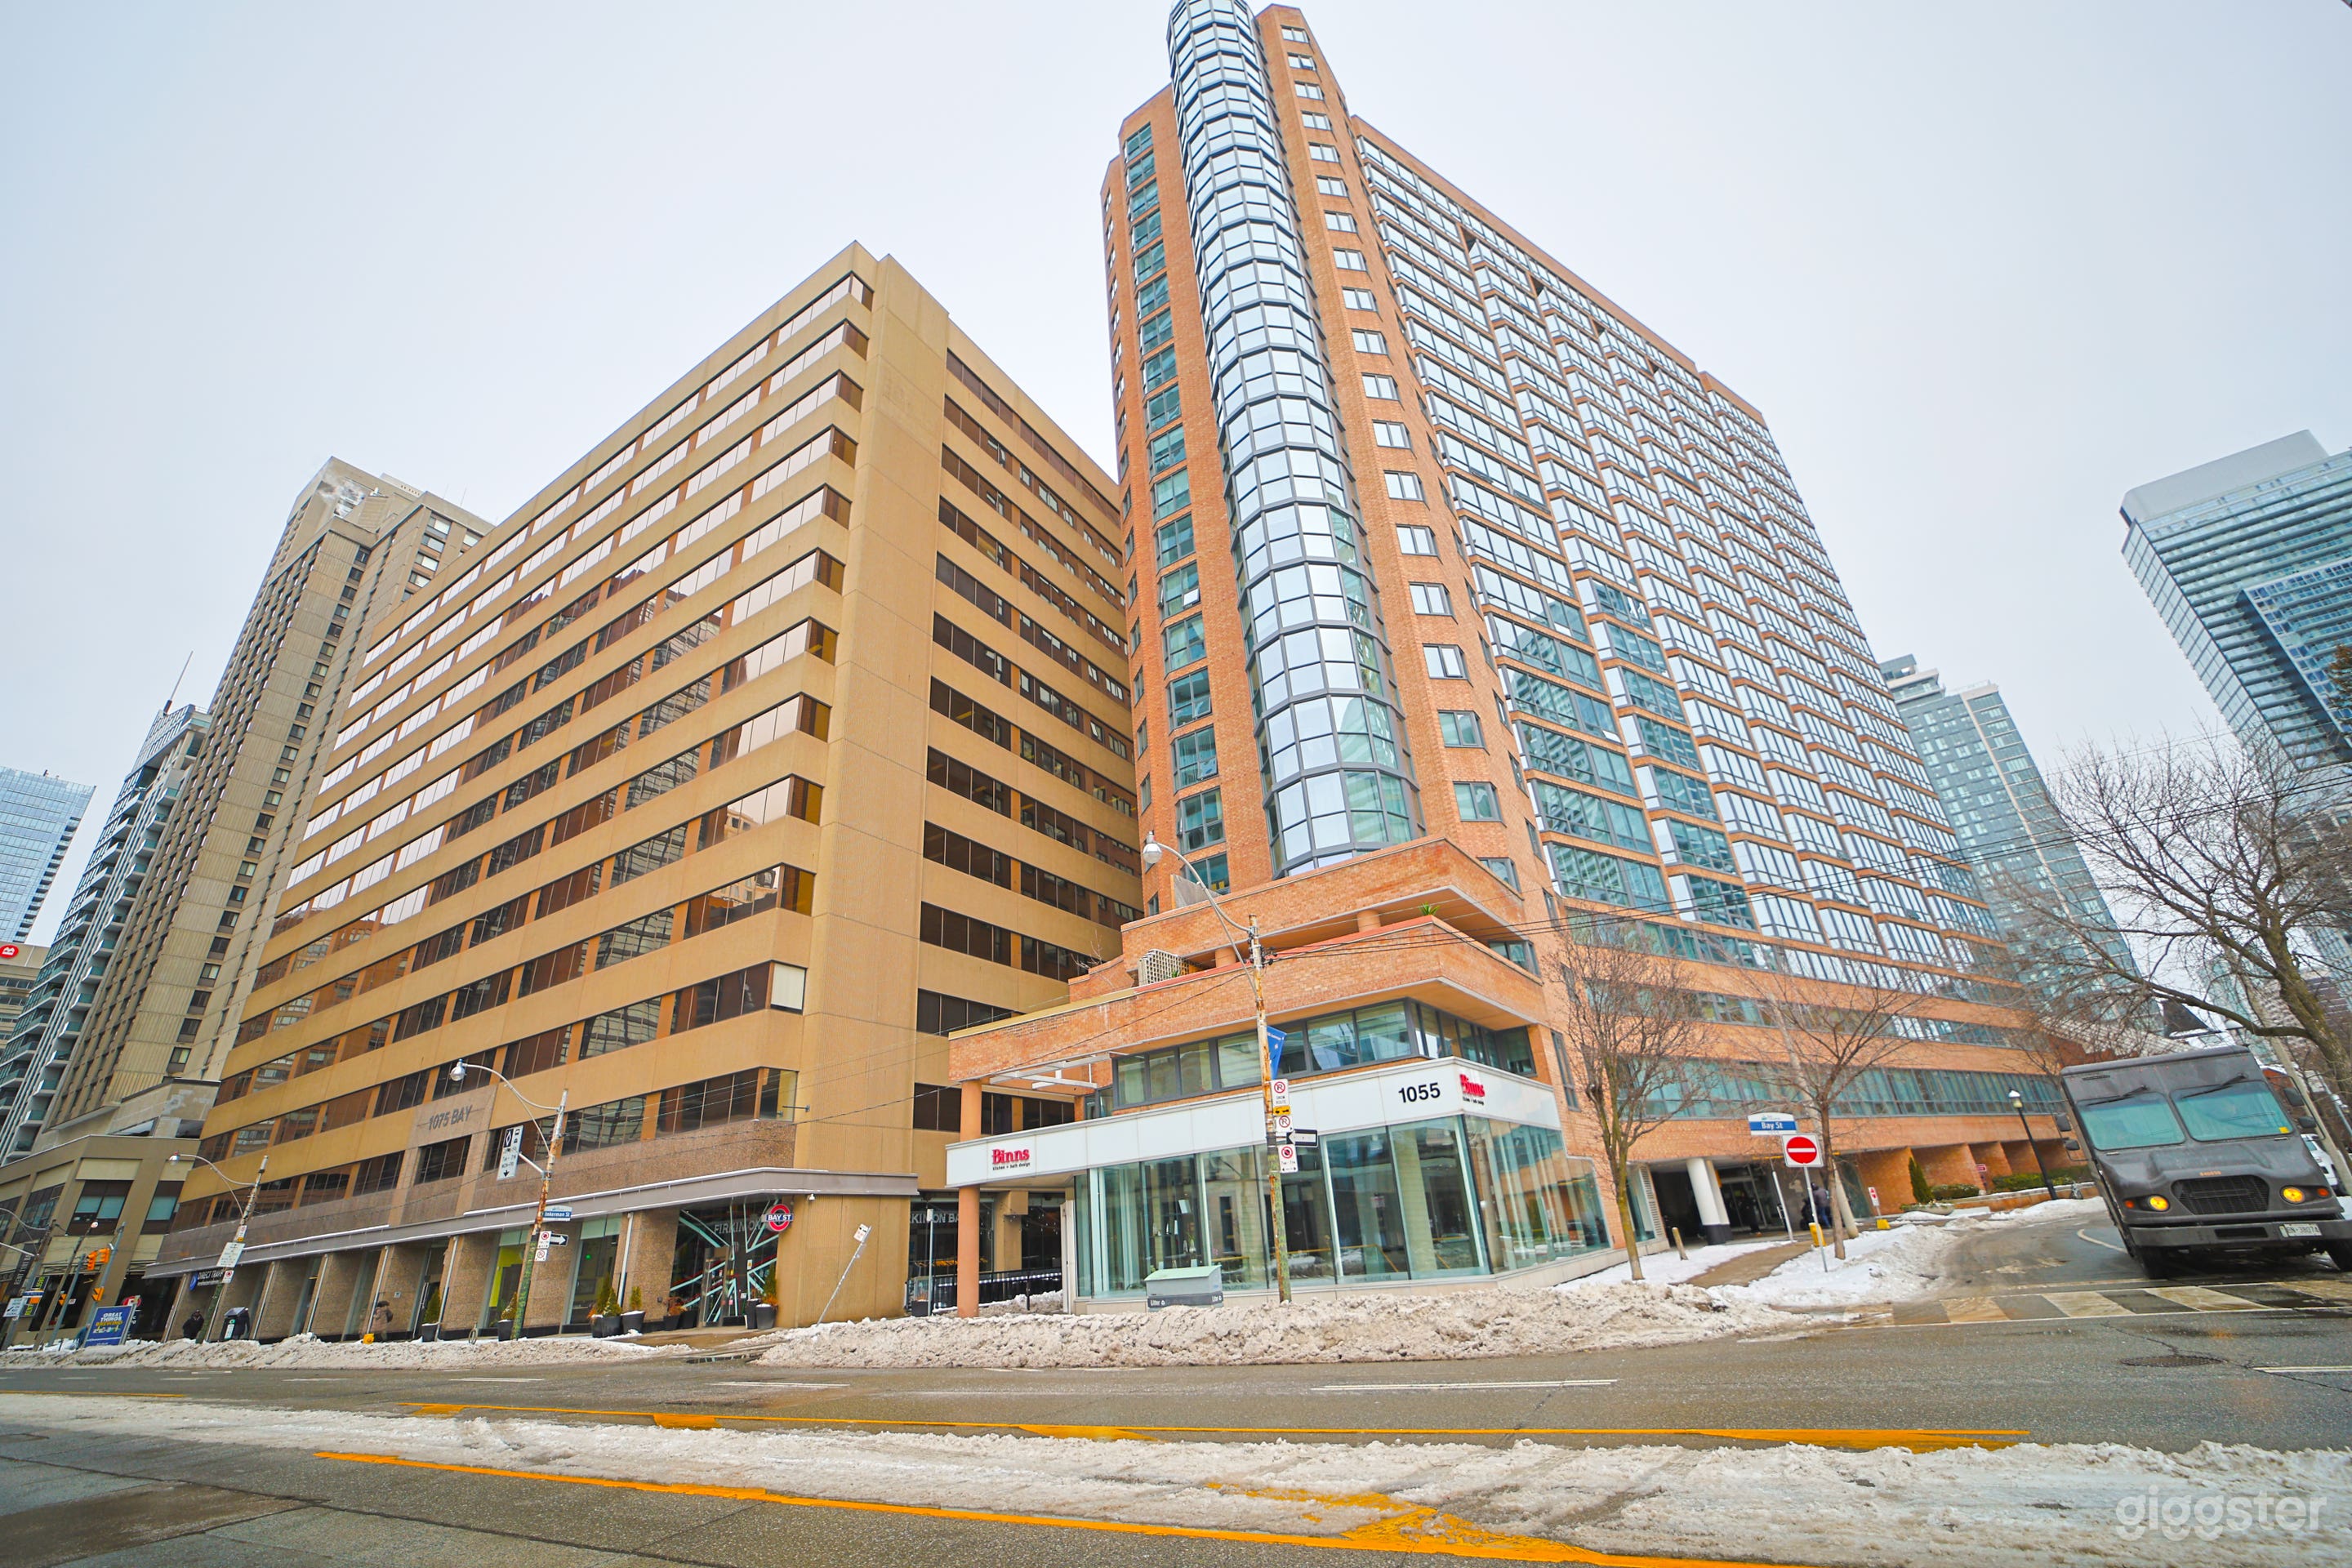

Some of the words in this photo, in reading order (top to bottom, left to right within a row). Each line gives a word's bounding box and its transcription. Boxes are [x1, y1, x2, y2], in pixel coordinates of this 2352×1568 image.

[1398, 1082, 1441, 1102] 1055
[1459, 1074, 1486, 1097] Binns
[429, 1111, 450, 1130] 1075
[451, 1104, 473, 1125] BAY
[1761, 1121, 1775, 1130] Bay
[991, 1149, 1030, 1165] Binns
[714, 1223, 745, 1234] FIRKIN
[198, 1270, 211, 1280] DIRECT
